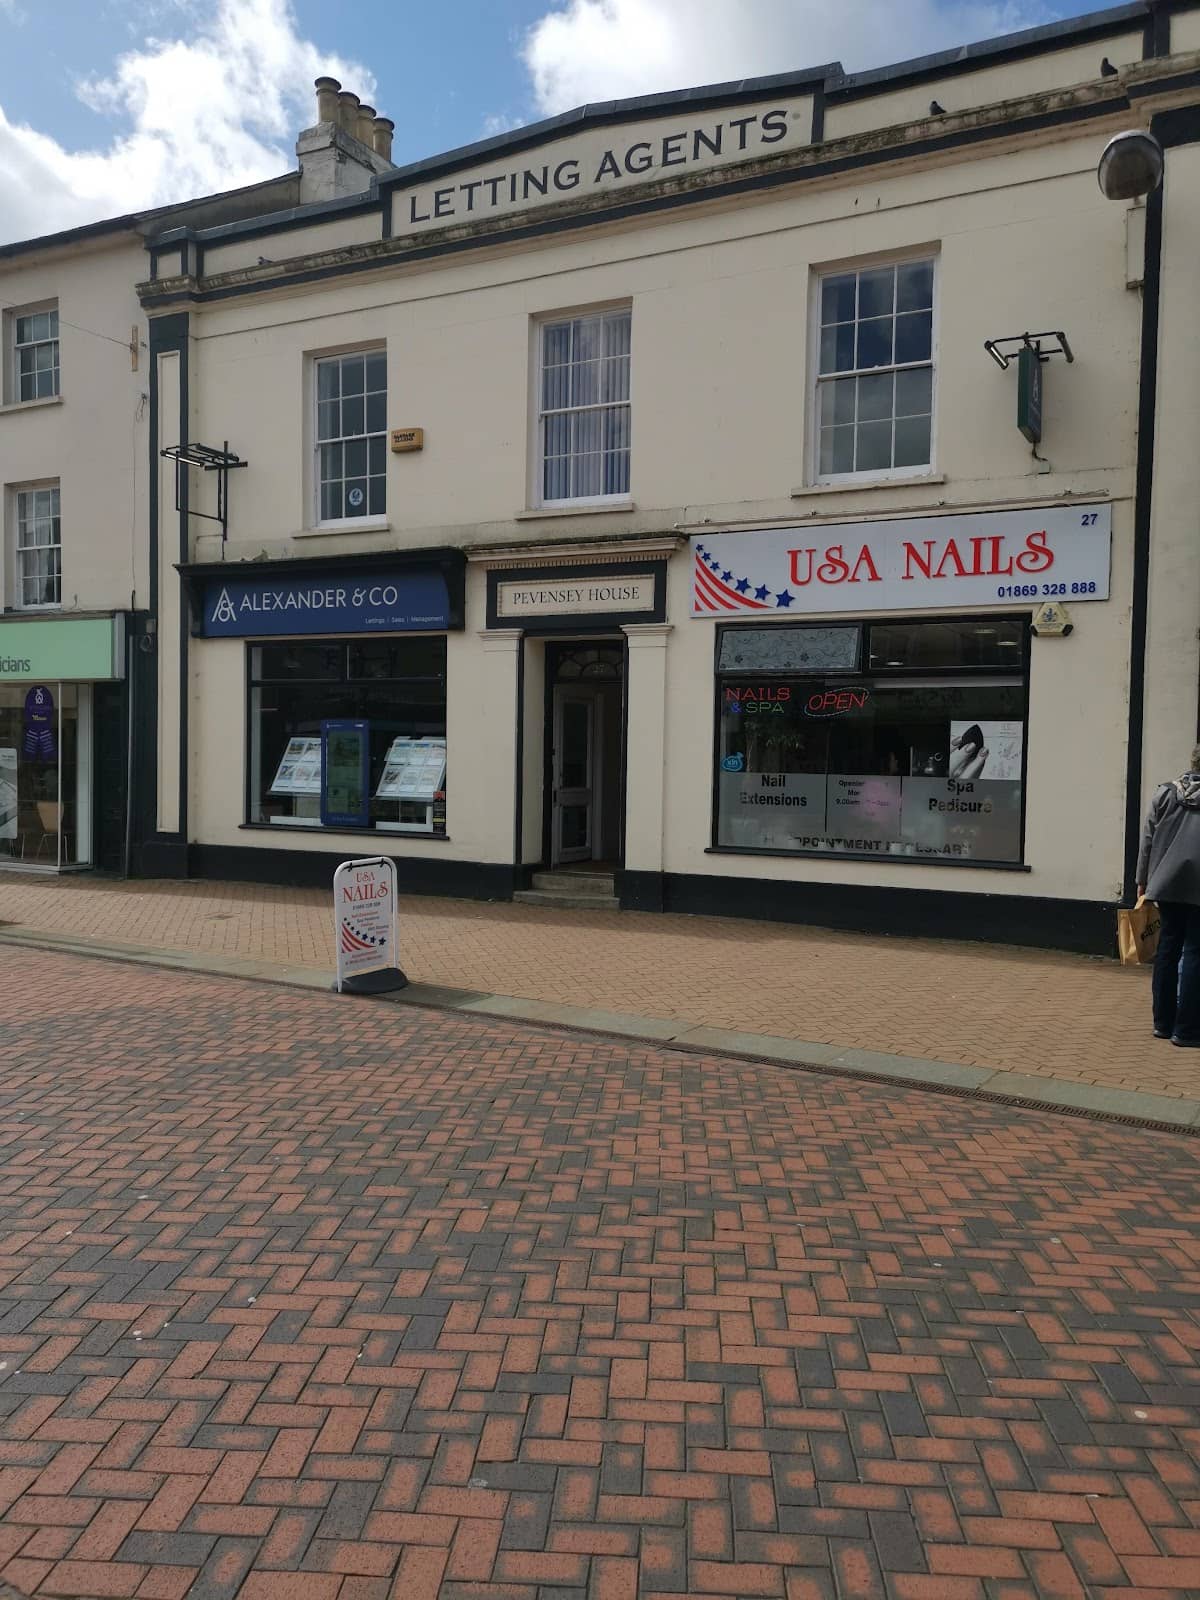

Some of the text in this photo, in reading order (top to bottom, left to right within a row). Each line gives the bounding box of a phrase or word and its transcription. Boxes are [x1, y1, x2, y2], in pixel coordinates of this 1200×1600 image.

[409, 110, 788, 224] LETTING AGENTS
[1081, 513, 1098, 527] 27
[787, 530, 1056, 585] USA NAILS
[513, 586, 640, 605] PEVENSEY HOUSE
[997, 581, 1097, 598] 01869 328 888
[240, 586, 398, 611] ALEXANDER & CO
[726, 687, 792, 702] NAILS
[808, 692, 866, 711] OPEN
[731, 702, 785, 713] & SPA
[761, 775, 786, 787] Nail
[947, 779, 975, 795] Spa
[740, 792, 807, 806] Extensions
[355, 871, 376, 883] USA
[342, 881, 389, 904] NAILS
